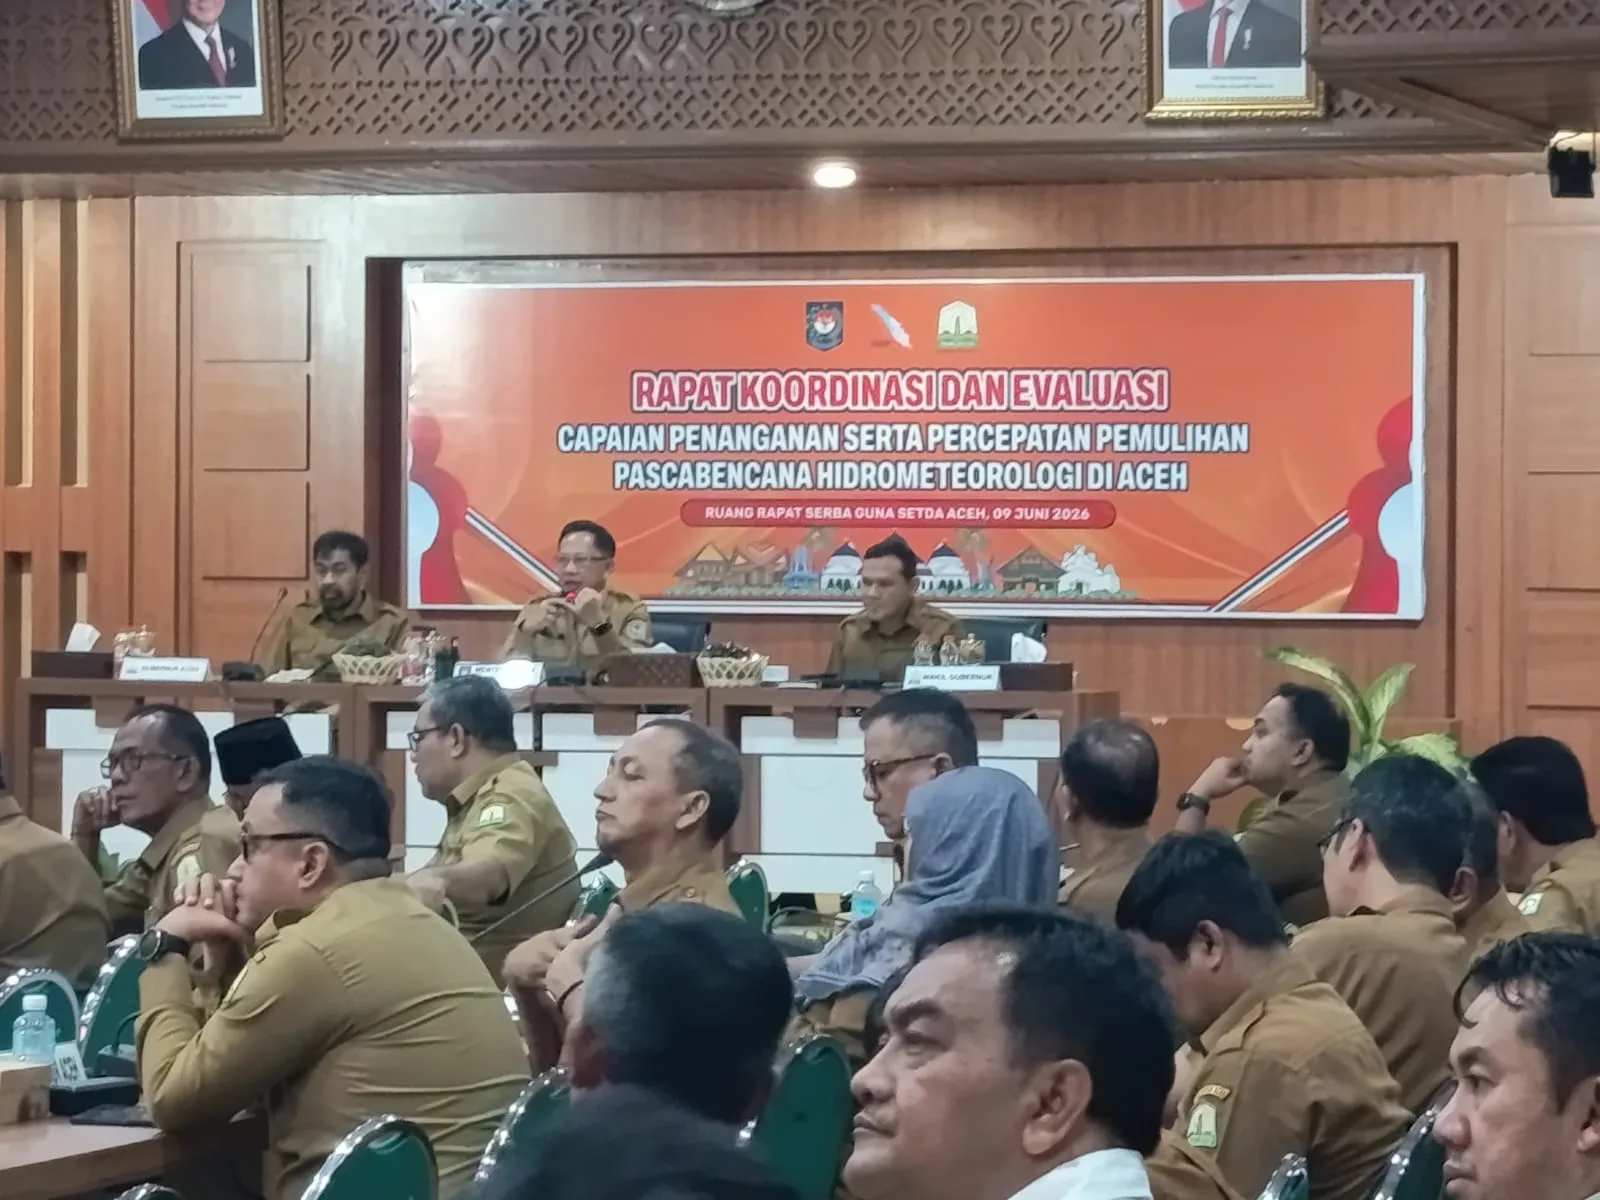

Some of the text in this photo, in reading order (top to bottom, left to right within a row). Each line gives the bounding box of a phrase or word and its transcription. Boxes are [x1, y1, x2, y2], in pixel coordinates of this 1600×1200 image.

[633, 369, 1169, 412] RAPAT KOORDINASI DAN EVALUASI
[558, 424, 1249, 452] CAPAIAN PENANGANAN SERTA PERCEPATAN PEMULIHAN
[613, 461, 1188, 490] PASCABENCANA HIDROMETEOROLOGI DI ACEH
[705, 506, 1090, 521] RUANG RAPAT SERBA GUNA SETDA ACEH, 09 JUNI 2026
